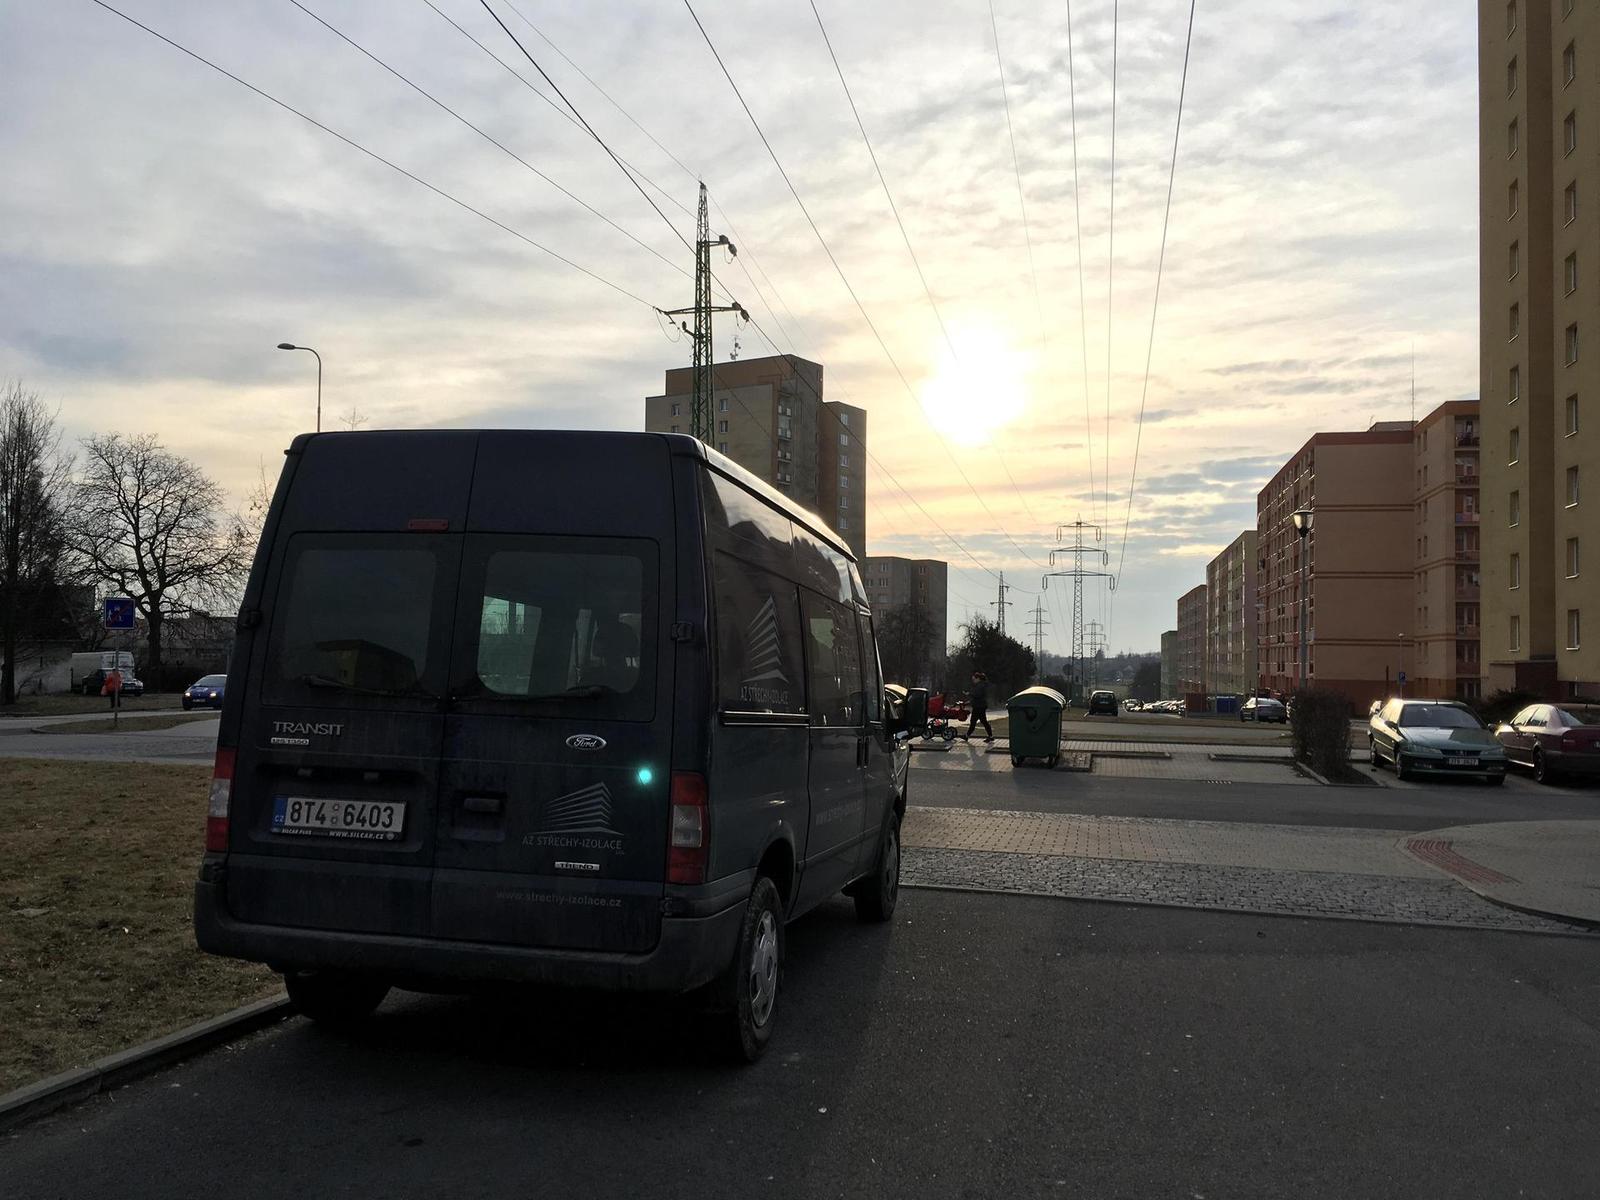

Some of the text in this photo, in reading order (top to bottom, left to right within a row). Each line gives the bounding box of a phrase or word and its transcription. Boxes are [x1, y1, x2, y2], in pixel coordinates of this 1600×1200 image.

[272, 720, 345, 737] TRANSIT
[290, 800, 395, 829] 8T4 6403
[521, 836, 534, 846] AZ
